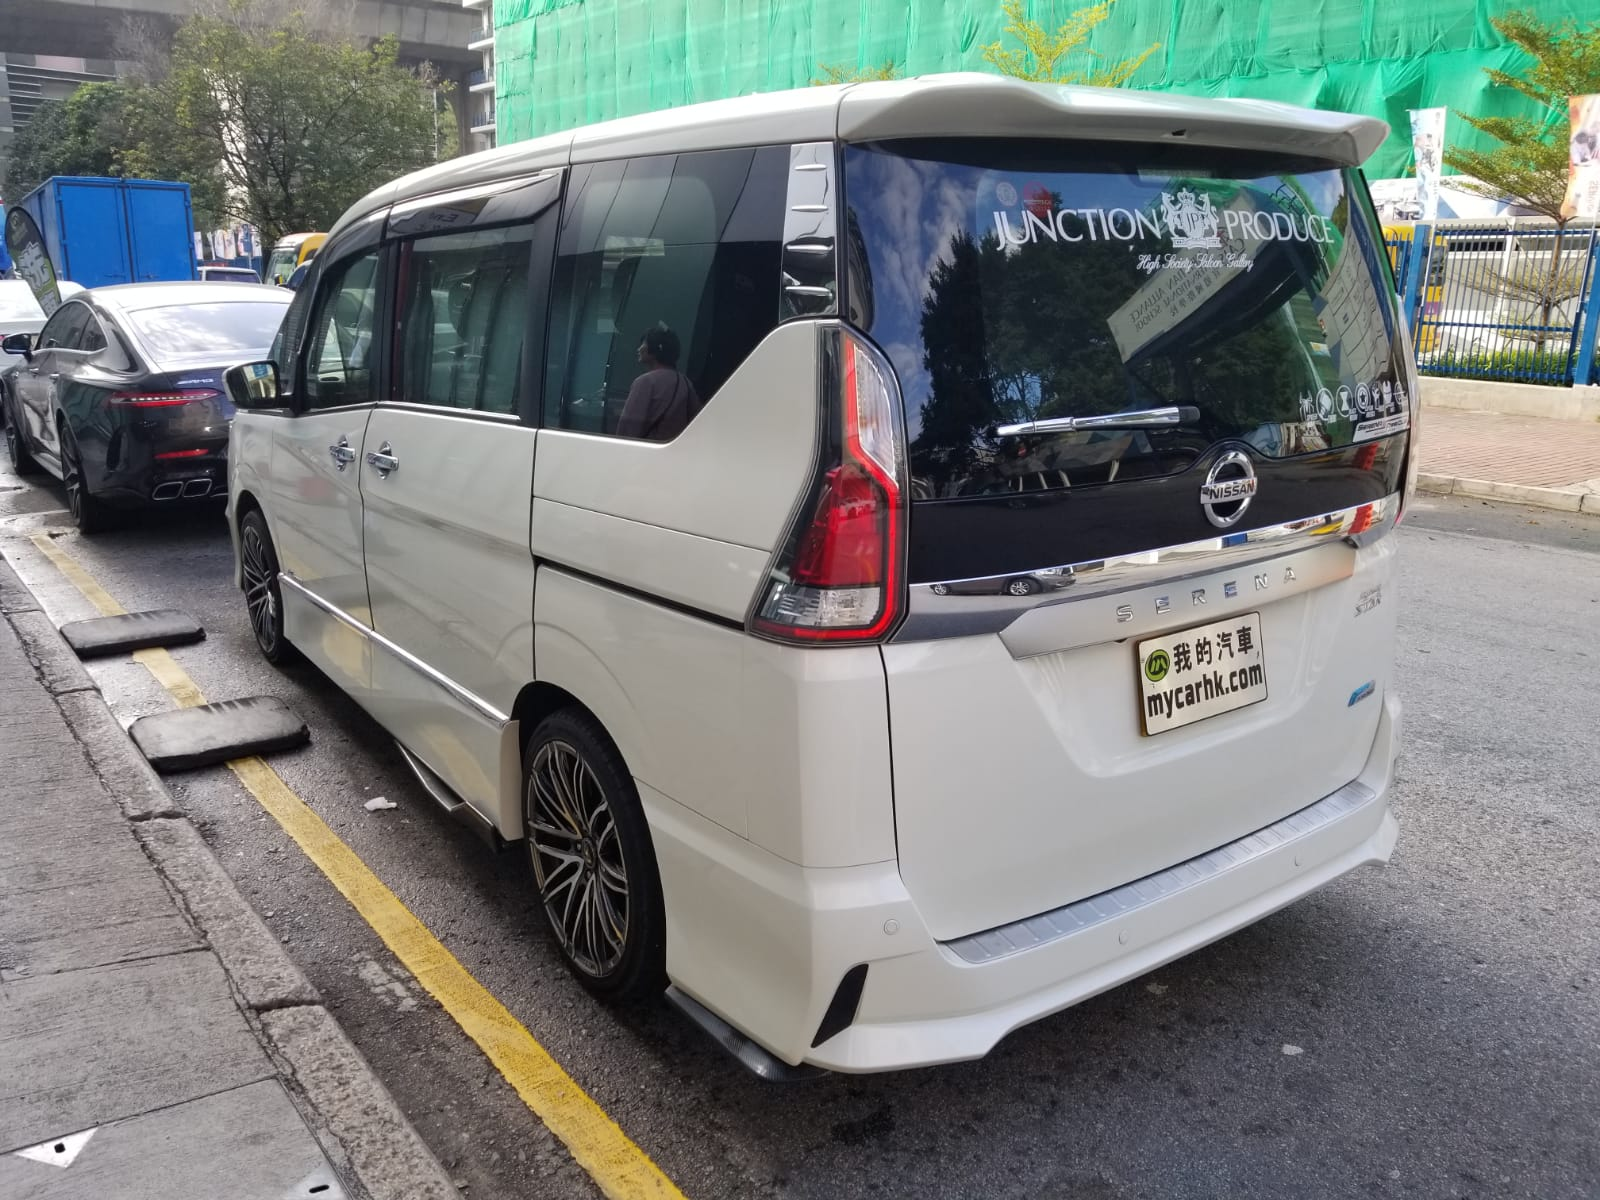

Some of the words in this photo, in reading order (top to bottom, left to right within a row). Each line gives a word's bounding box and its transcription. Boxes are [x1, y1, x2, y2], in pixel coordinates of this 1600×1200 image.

[993, 208, 1162, 251] JUNCTION
[1223, 210, 1334, 243] PRODUCE
[1136, 253, 1160, 274] High
[1162, 253, 1192, 273] Society
[1209, 481, 1256, 500] NISSAN
[1116, 567, 1297, 623] SERENA
[1173, 626, 1254, 674] 我的汽車
[1147, 664, 1263, 718] mycarhk.com
